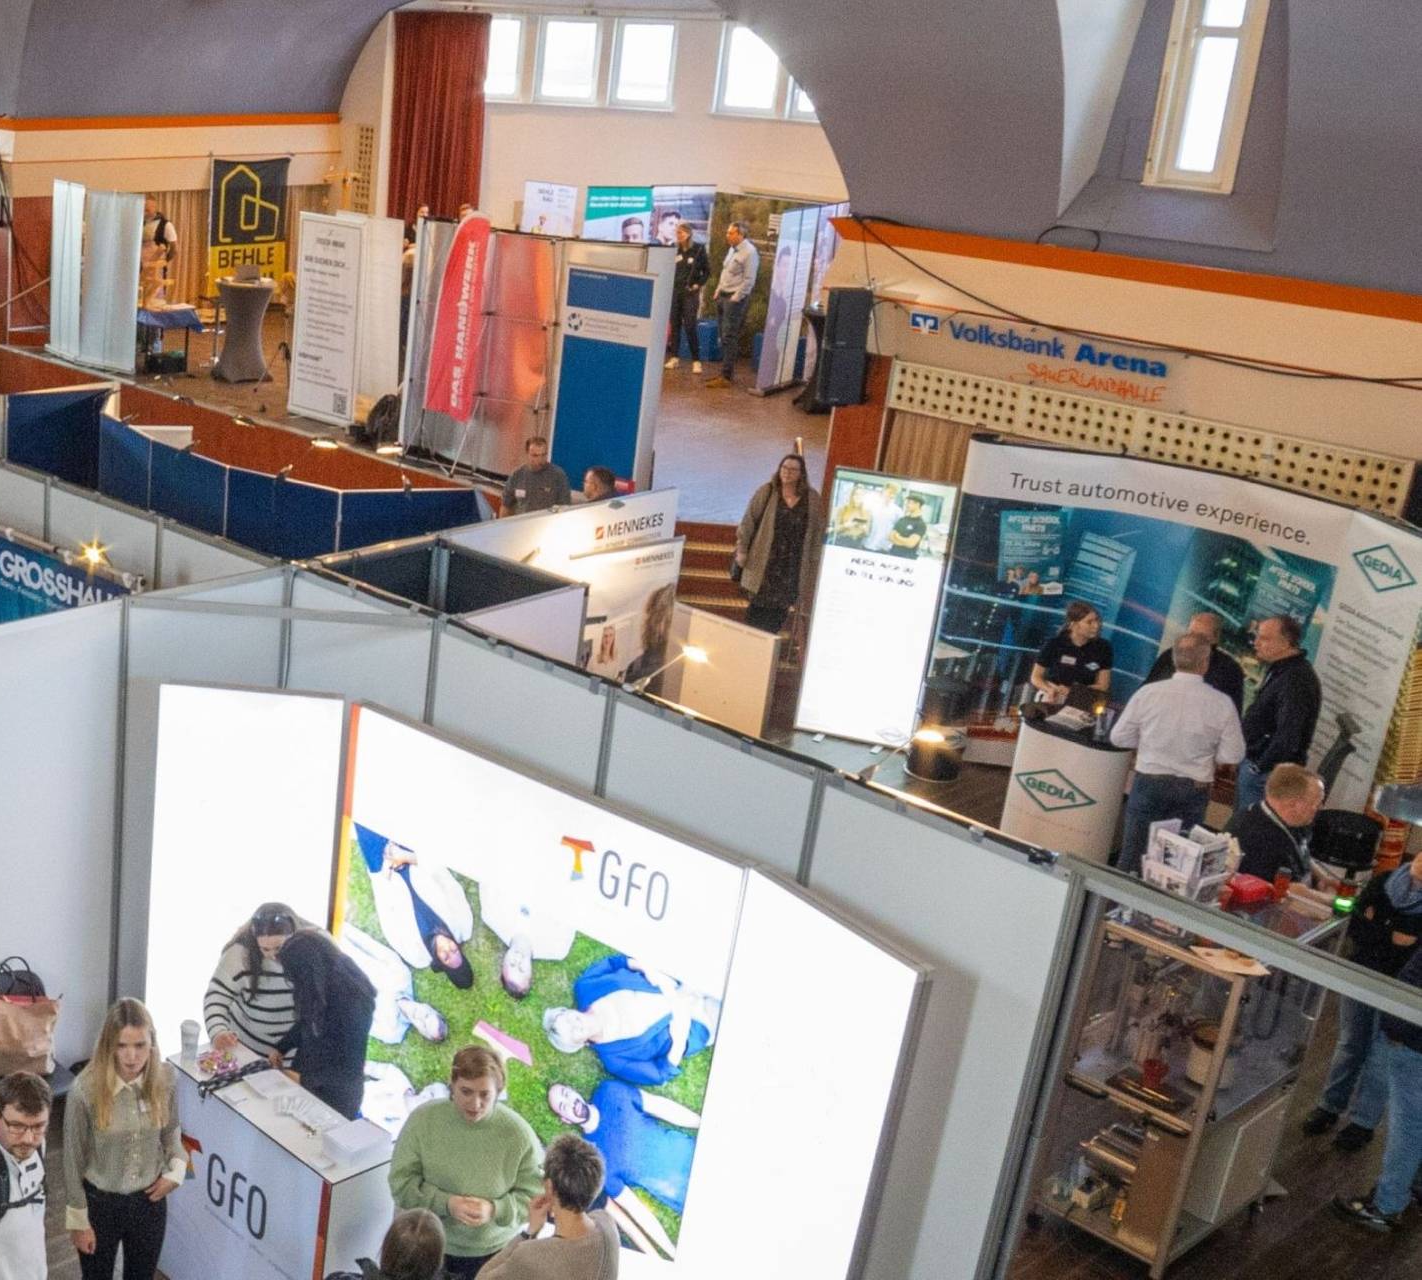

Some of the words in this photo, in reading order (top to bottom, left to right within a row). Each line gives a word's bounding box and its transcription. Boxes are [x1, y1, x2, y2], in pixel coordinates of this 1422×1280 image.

[218, 247, 275, 269] BEHLE
[455, 240, 476, 360] HANDWERK
[949, 320, 1065, 359] Volksbank
[1075, 344, 1167, 377] Arena
[450, 365, 461, 408] DAS
[607, 512, 664, 538] MENNEKES
[1010, 472, 1063, 494] Trust
[1067, 479, 1190, 513] automotive
[1195, 501, 1311, 545] experience.
[0, 550, 118, 606] GROSSHA
[1364, 555, 1402, 581] GEDIA
[1025, 777, 1076, 802] GEDIA
[599, 850, 669, 921] GFO
[207, 1153, 267, 1240] GFO
